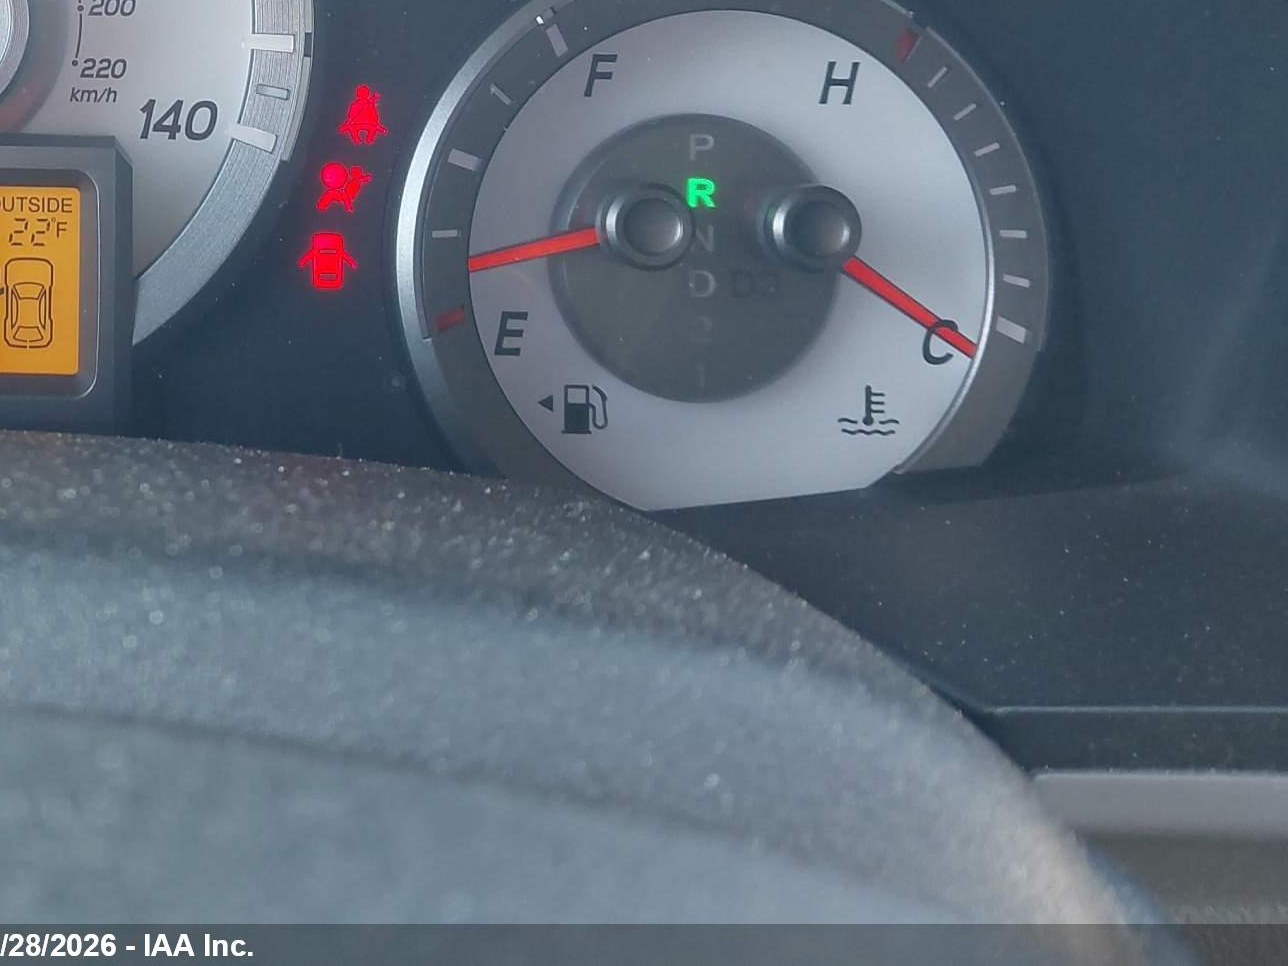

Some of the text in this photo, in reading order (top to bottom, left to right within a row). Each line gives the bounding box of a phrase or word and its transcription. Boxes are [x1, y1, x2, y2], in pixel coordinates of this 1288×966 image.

[80, 58, 126, 78] 220
[584, 54, 617, 97] F
[819, 61, 860, 104] H
[70, 87, 117, 103] km/h
[140, 99, 217, 140] 140
[690, 134, 714, 160] P
[687, 178, 715, 207] R
[688, 271, 716, 297] D
[494, 311, 528, 356] E
[922, 320, 961, 365] C
